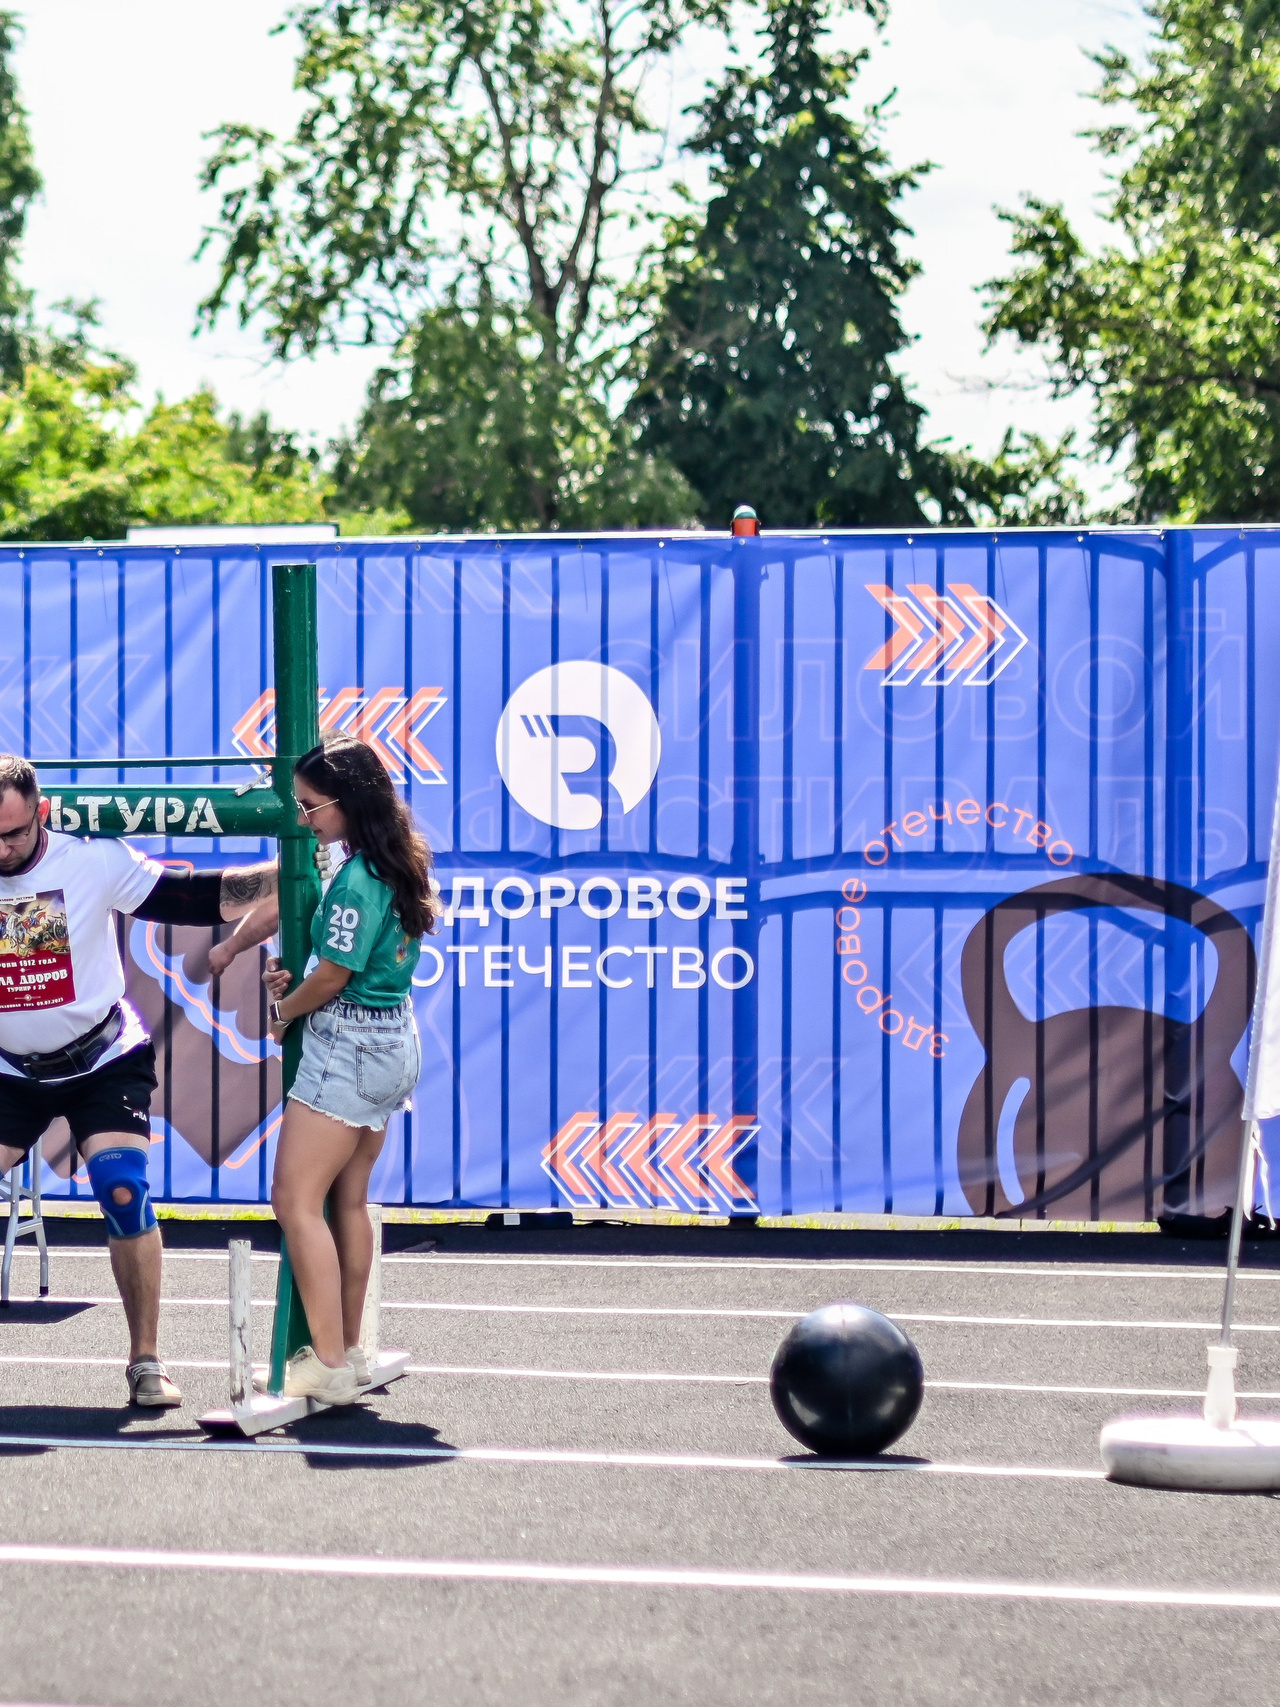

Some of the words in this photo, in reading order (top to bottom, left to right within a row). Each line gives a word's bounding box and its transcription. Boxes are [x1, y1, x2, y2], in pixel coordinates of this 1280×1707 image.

[863, 798, 1074, 866] отечество
[329, 904, 359, 930] 20
[326, 926, 355, 953] 23
[19, 969, 68, 985] ДВОРОВ
[411, 945, 756, 990] ОТЕЧЕСТВО
[835, 877, 950, 1059] здоровое
